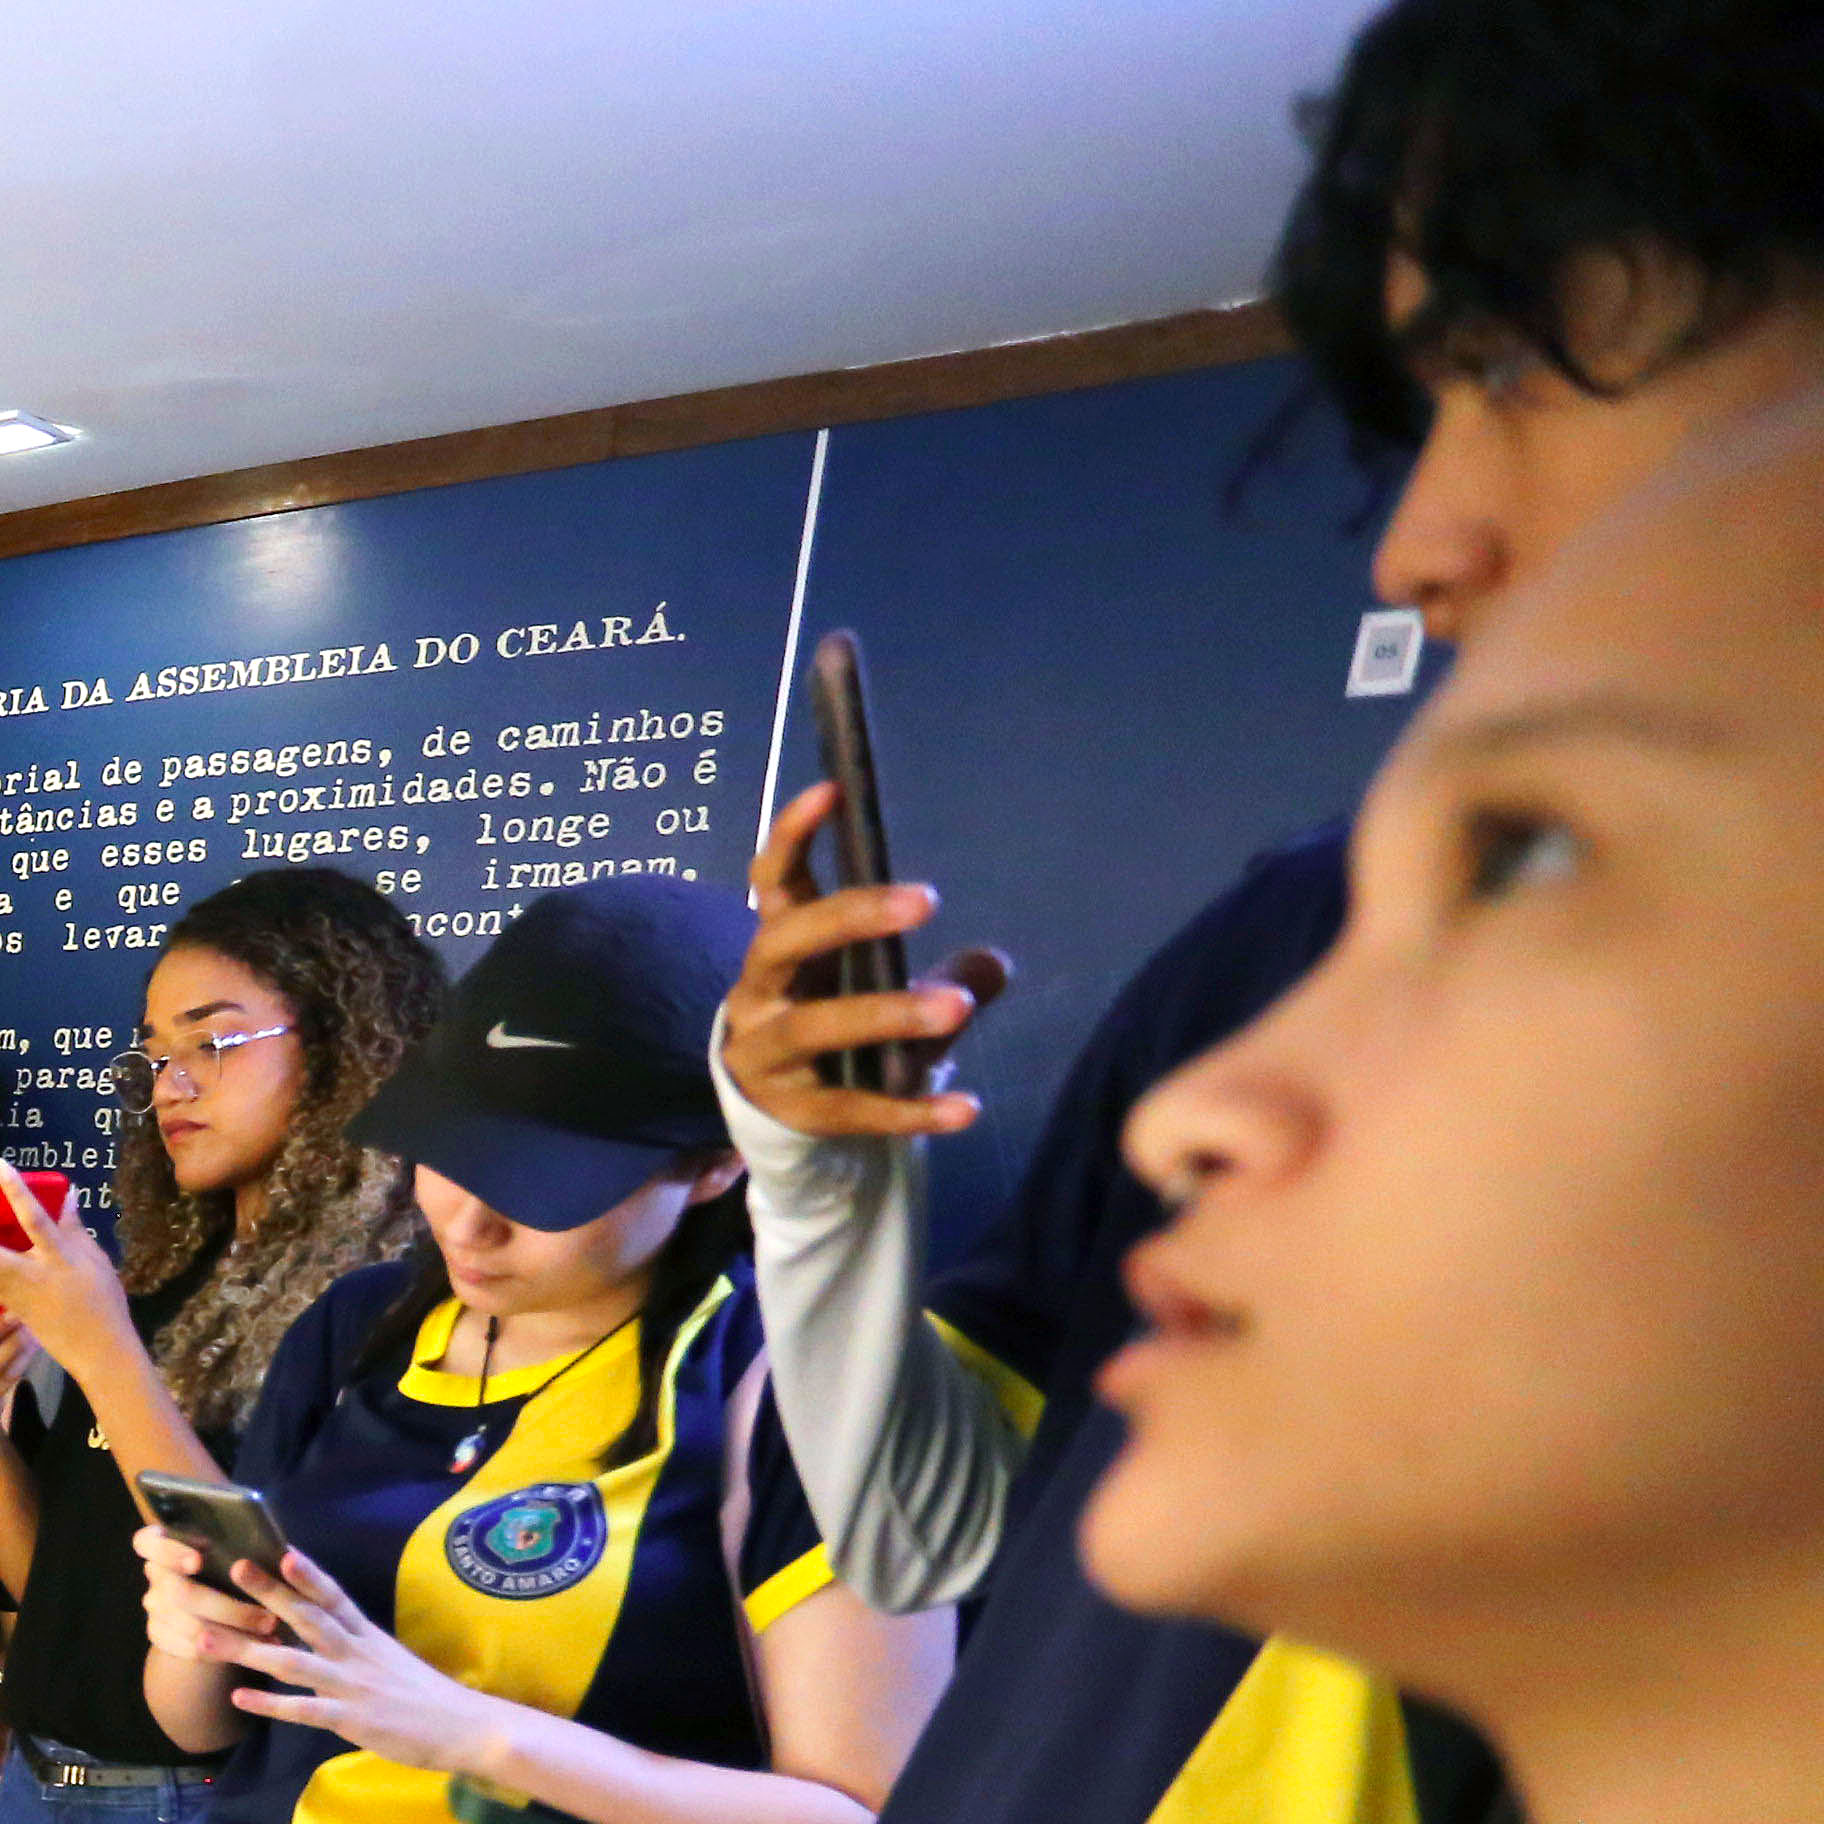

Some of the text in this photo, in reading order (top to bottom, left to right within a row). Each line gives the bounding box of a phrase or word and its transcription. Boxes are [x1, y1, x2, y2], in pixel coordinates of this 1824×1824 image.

[60, 677, 114, 710] DA
[125, 642, 398, 701] ASSEMBLEIA
[413, 632, 481, 669] DO
[496, 600, 686, 660] CEARÁ.
[101, 755, 143, 786] de
[158, 734, 395, 787] passagens,
[422, 725, 471, 758] de
[497, 709, 725, 753] caminhos
[156, 799, 175, 823] e
[192, 793, 216, 822] a
[227, 767, 555, 826] proximidades.
[579, 756, 667, 794] Não
[693, 747, 718, 785] é
[10, 847, 70, 881] que
[101, 836, 208, 868] esses
[240, 819, 431, 863] lugares,
[476, 810, 612, 850] longe
[655, 804, 711, 836] ou
[55, 887, 74, 911] e
[118, 880, 181, 914] que
[374, 866, 423, 895] se
[53, 1022, 114, 1056] que
[502, 1557, 581, 1591] AMARO
